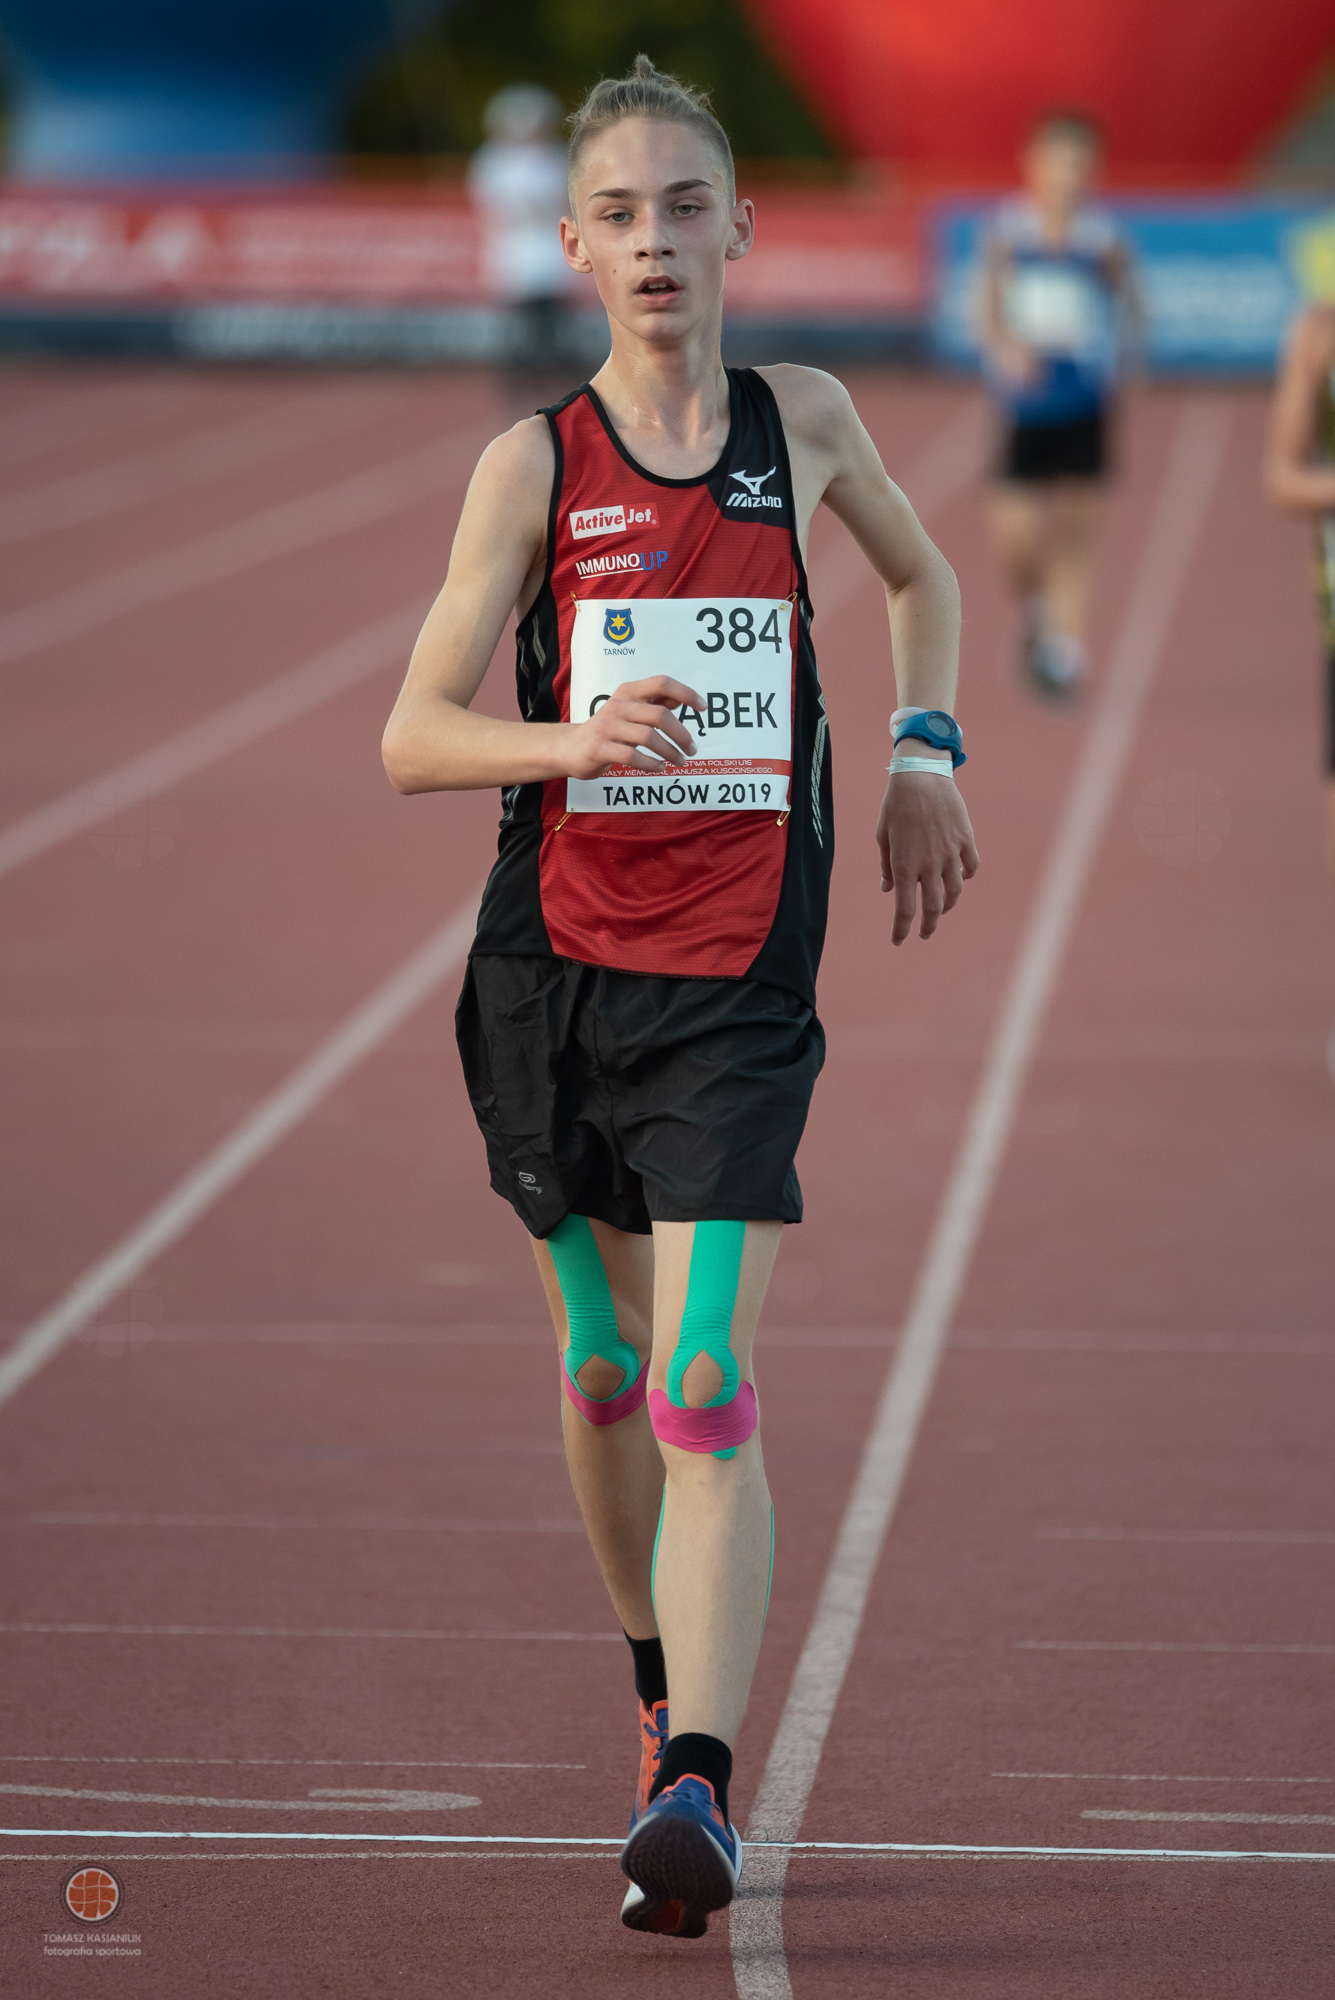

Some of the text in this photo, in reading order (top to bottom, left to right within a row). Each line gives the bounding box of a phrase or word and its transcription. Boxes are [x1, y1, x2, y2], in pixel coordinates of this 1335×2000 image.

[726, 492, 783, 508] MIZUNO
[695, 607, 783, 654] 384
[603, 646, 636, 656] TARNÓW
[589, 691, 778, 736] ĄBEK
[670, 767, 709, 776] JANUSZA
[603, 778, 772, 806] TARNÓW 2019
